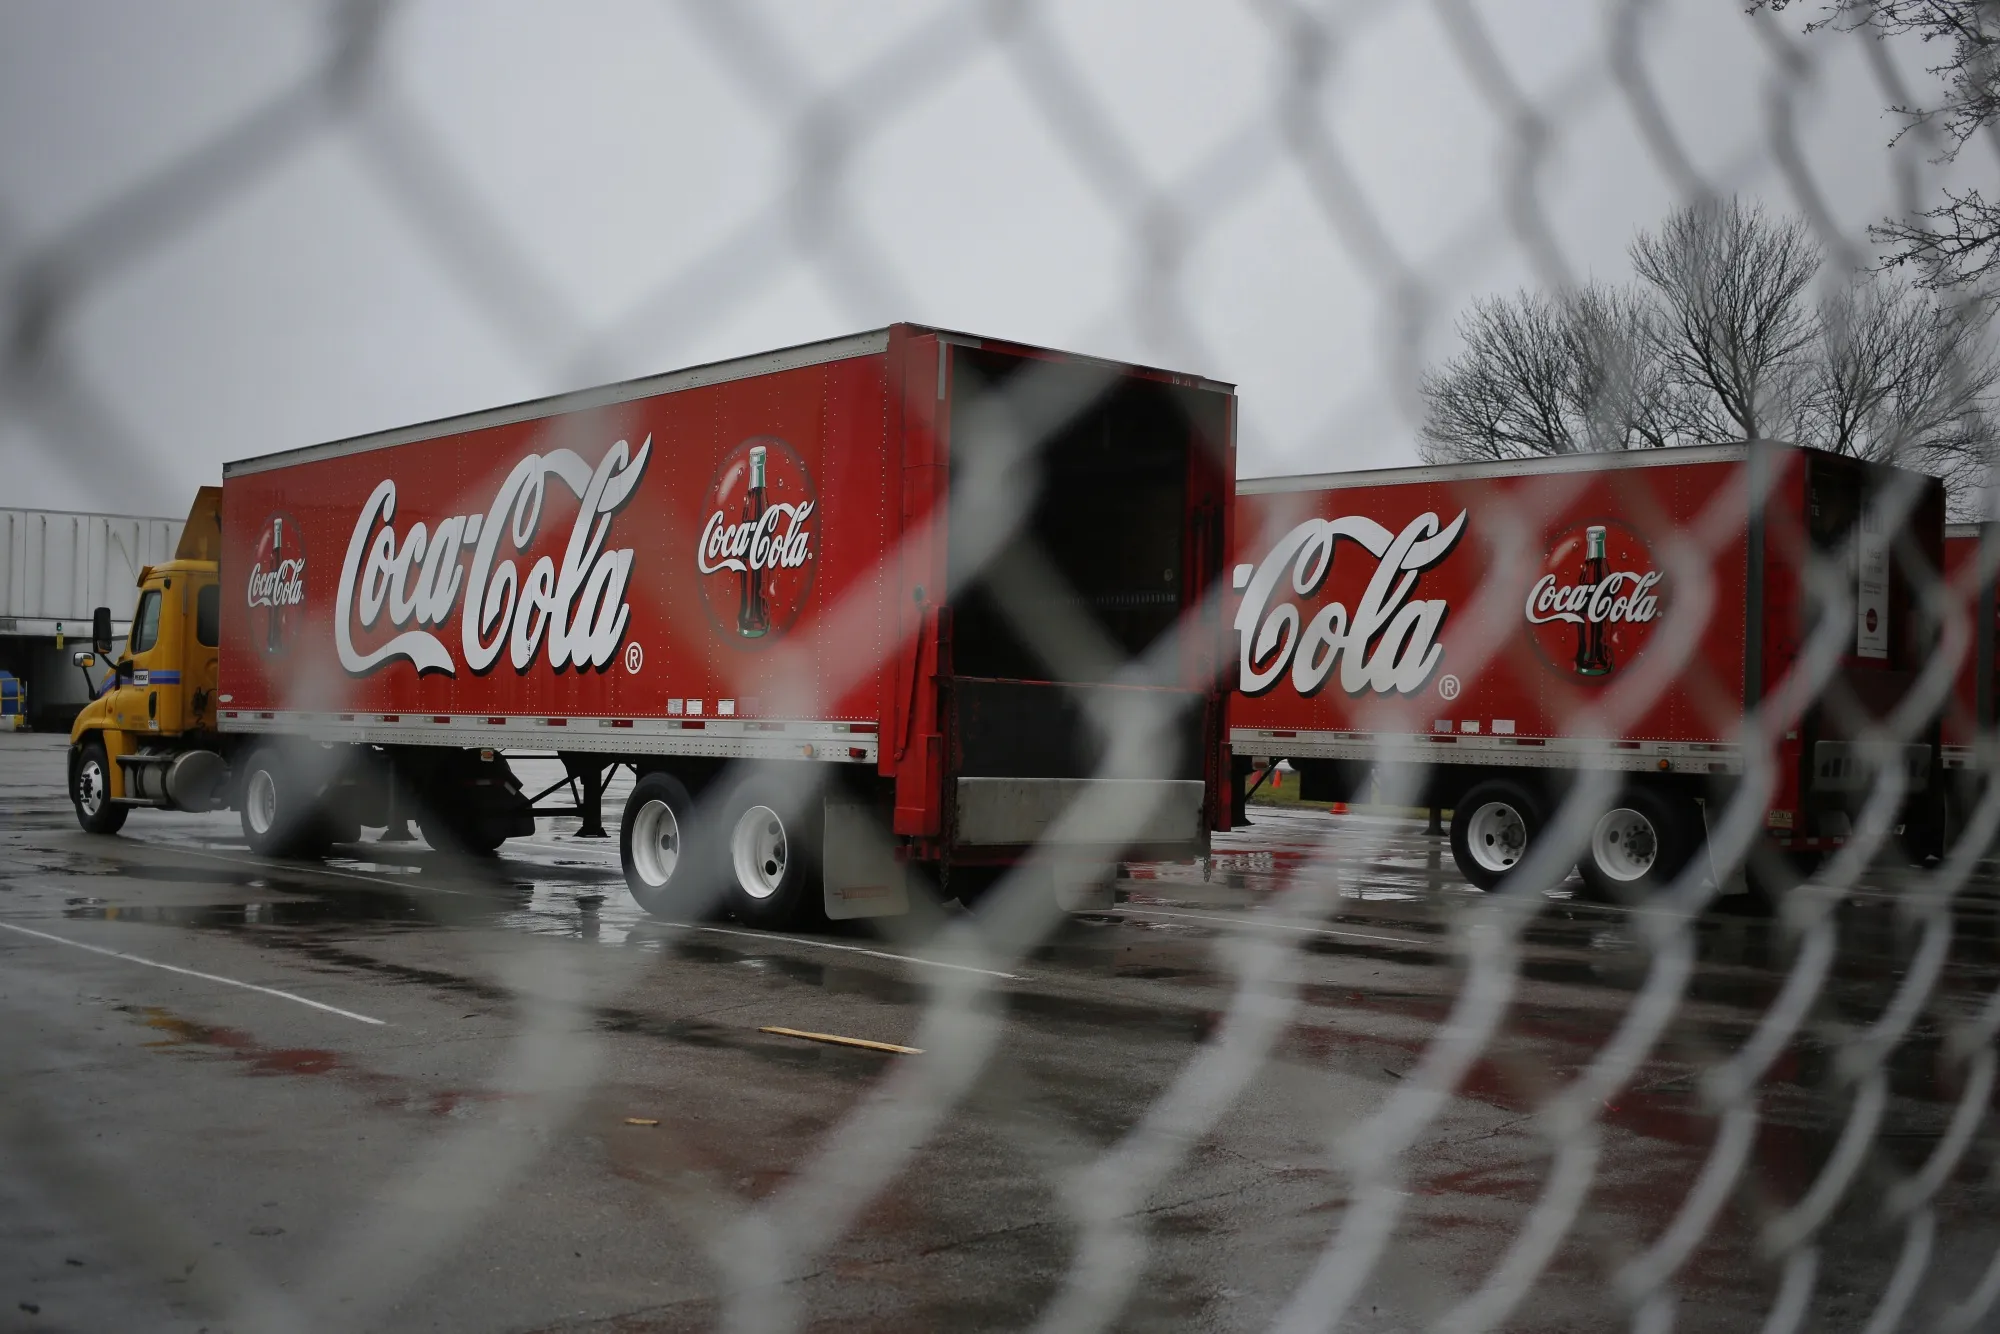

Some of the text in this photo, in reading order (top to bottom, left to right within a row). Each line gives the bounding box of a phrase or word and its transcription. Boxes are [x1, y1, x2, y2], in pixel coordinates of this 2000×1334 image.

[335, 432, 652, 677] Coca-Cola
[698, 499, 815, 574] Coca-Cola
[247, 558, 306, 608] Coca-Cola
[1525, 570, 1665, 624] Coca-Cola
